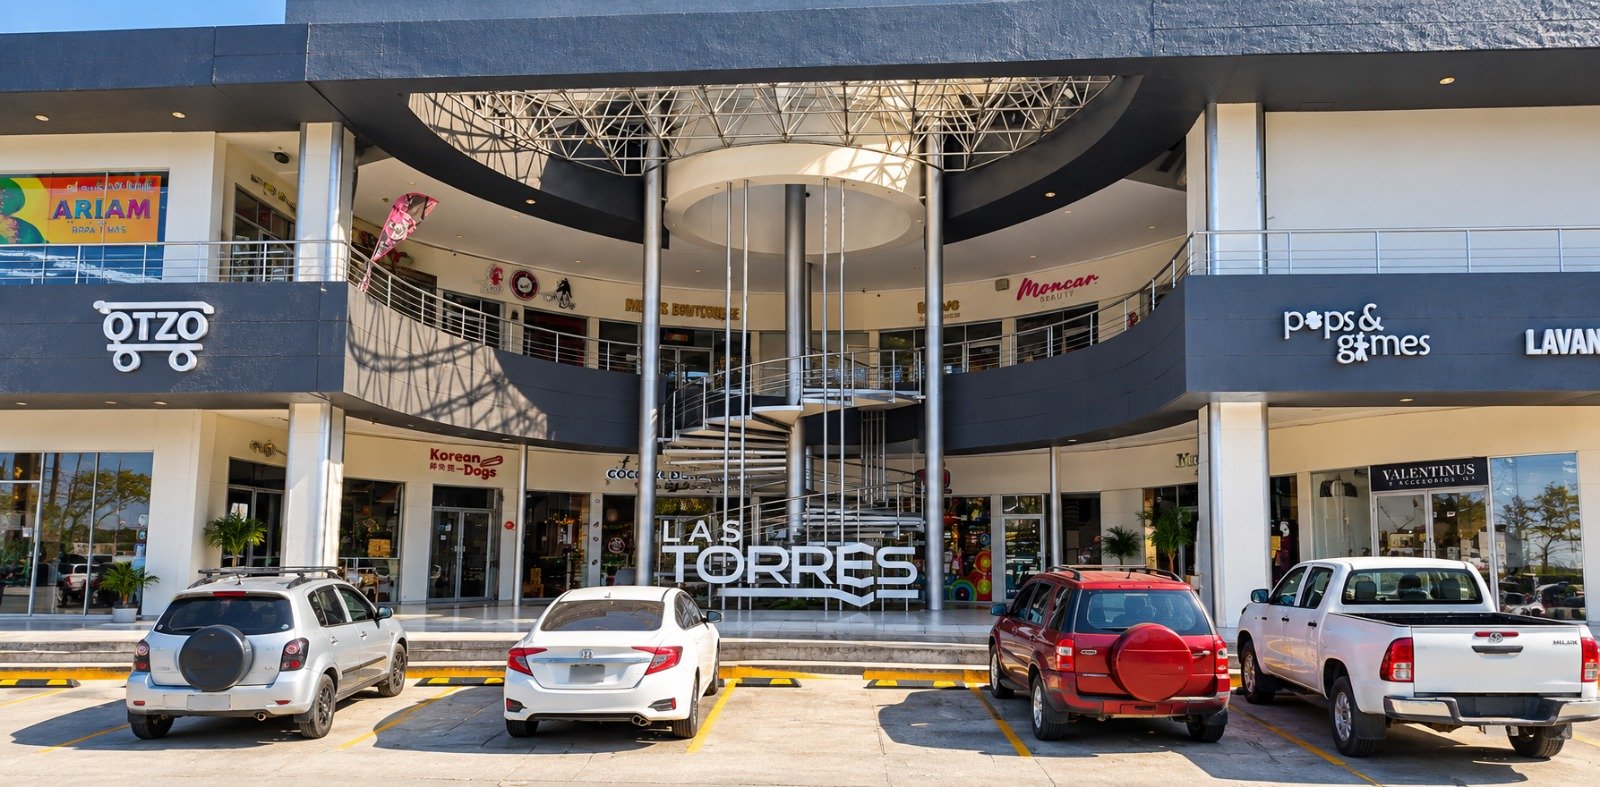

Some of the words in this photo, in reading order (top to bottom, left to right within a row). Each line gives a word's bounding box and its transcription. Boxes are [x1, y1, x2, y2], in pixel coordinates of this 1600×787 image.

[52, 198, 151, 220] ARIAM
[1016, 274, 1099, 301] Moncar
[1039, 290, 1074, 303] BEAUTY
[103, 311, 210, 341] OTZO
[1358, 302, 1384, 332] &
[1525, 328, 1600, 355] LAVAN
[430, 448, 481, 463] Korean
[464, 464, 497, 480] Dogs
[1382, 463, 1476, 481] VALENTINUS
[663, 520, 741, 543] LAS
[661, 542, 919, 588] TORRES
